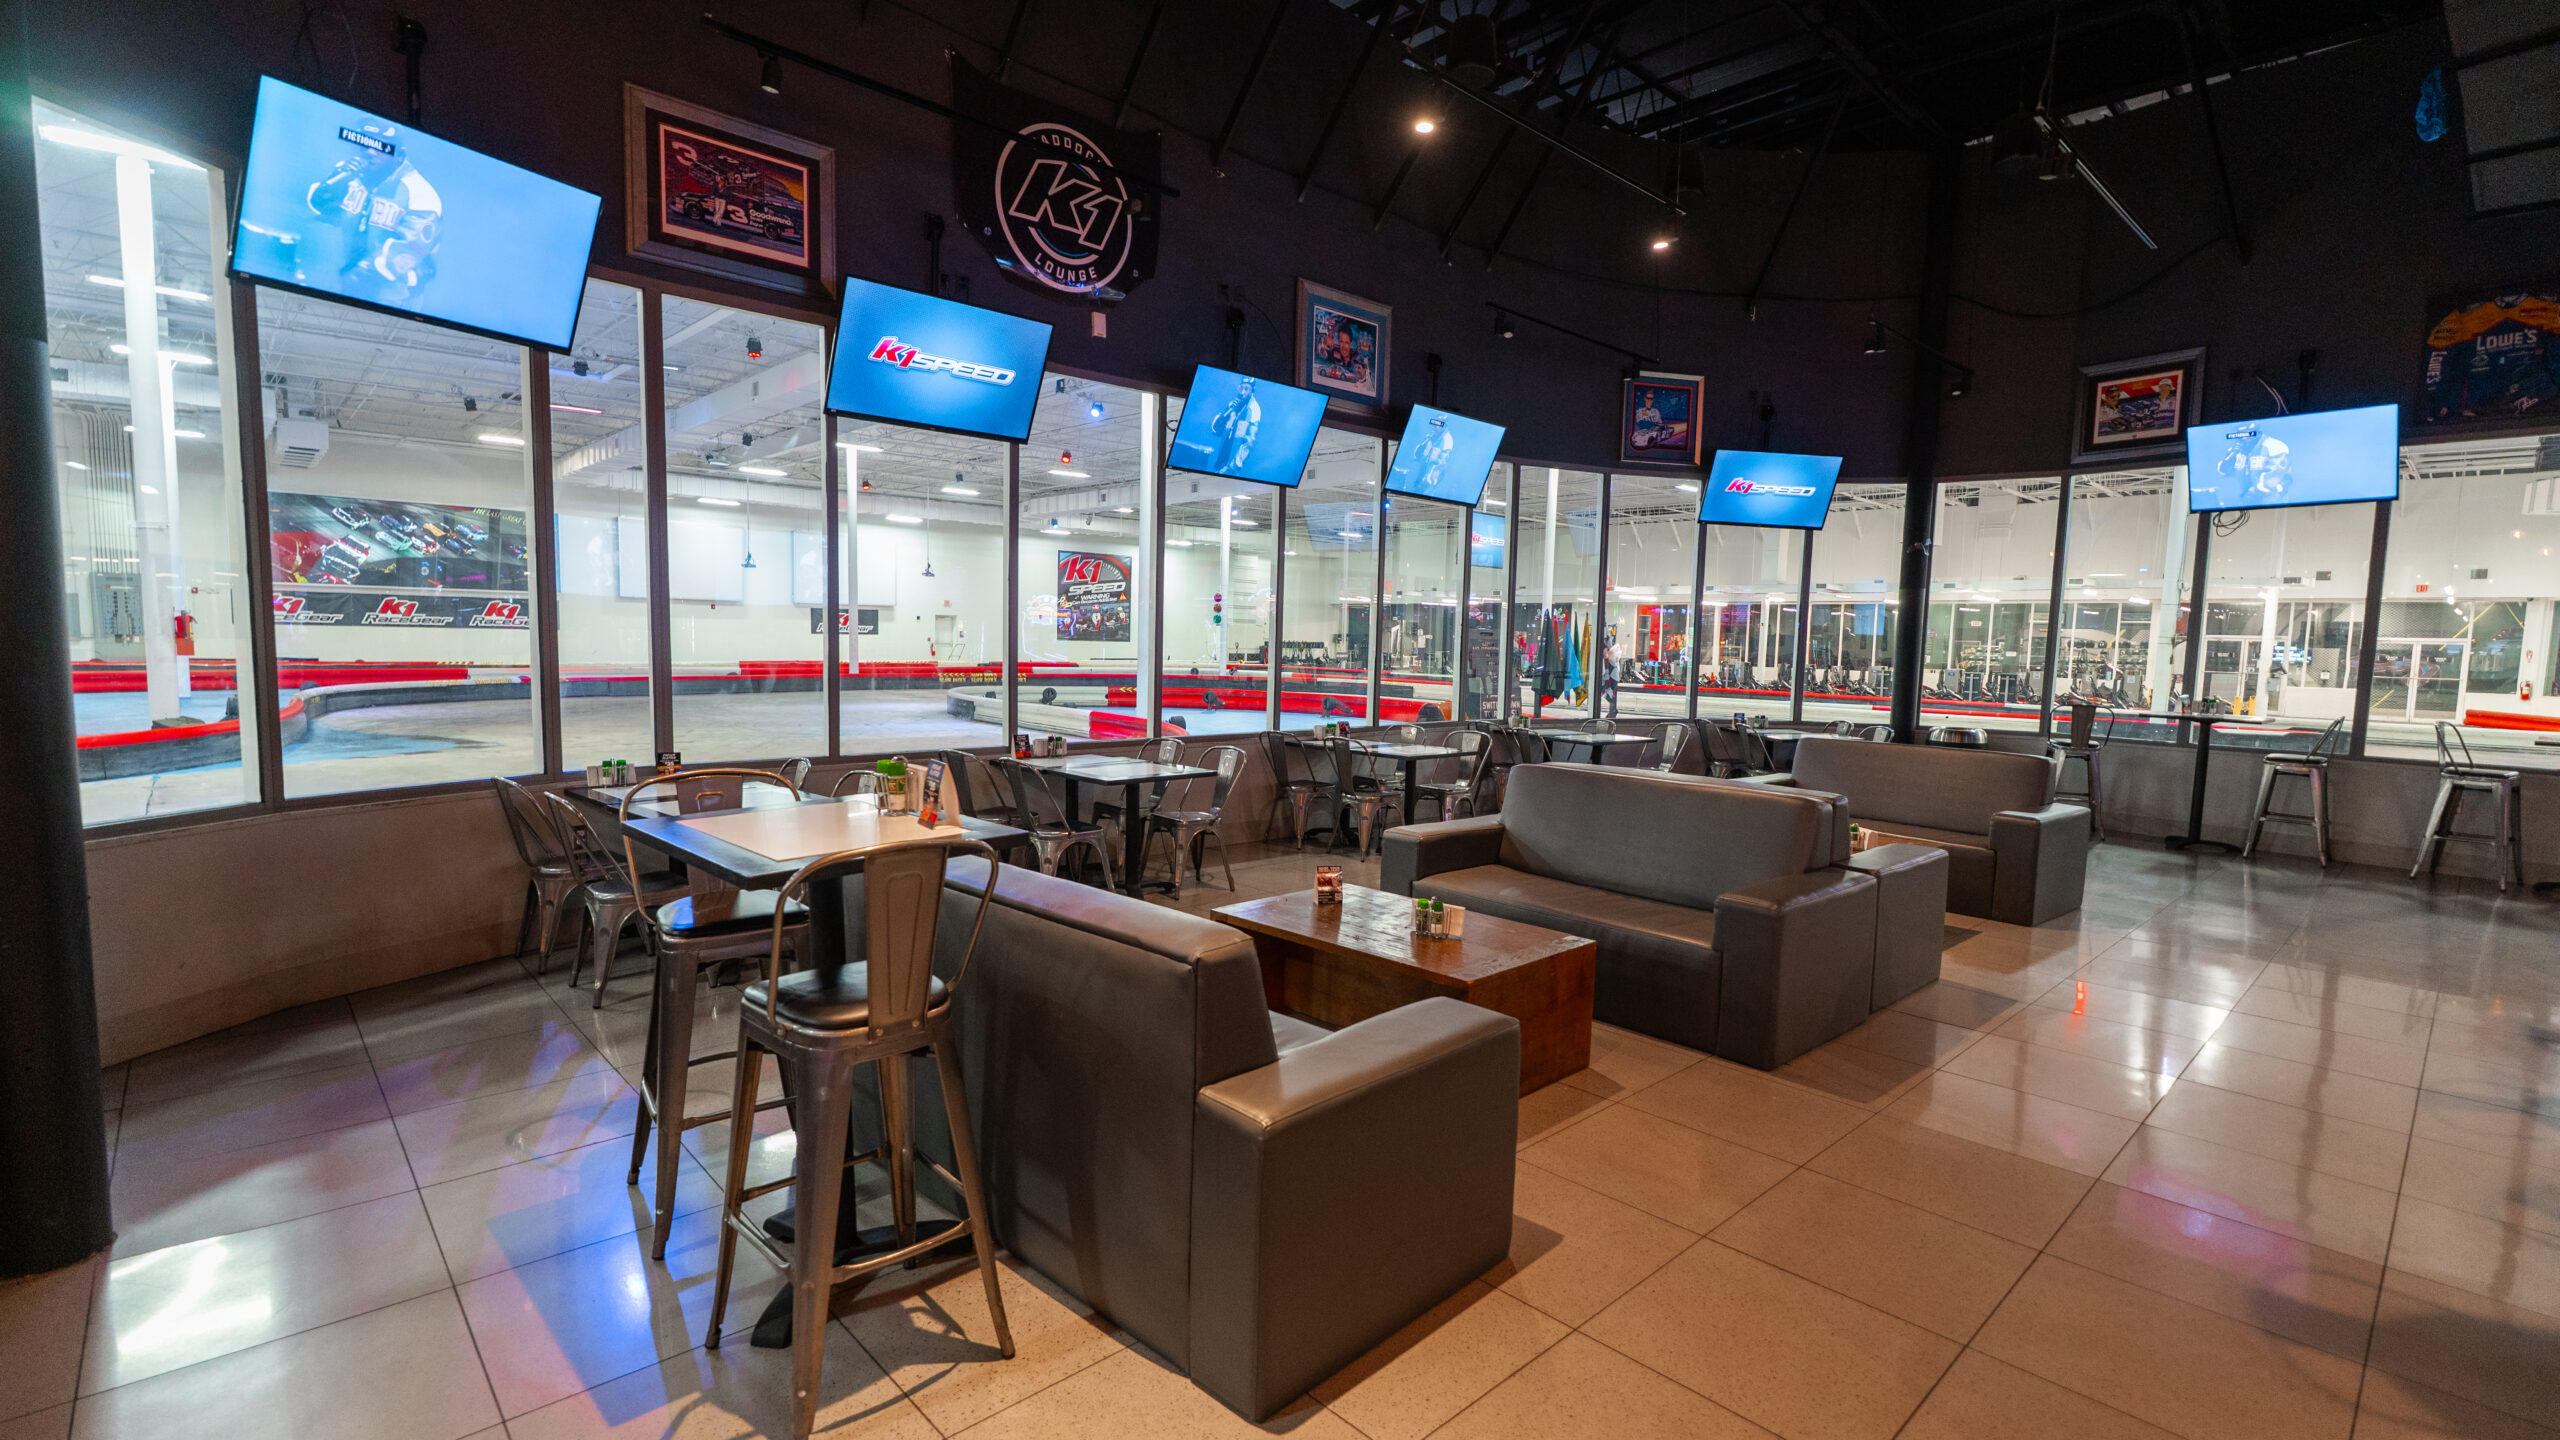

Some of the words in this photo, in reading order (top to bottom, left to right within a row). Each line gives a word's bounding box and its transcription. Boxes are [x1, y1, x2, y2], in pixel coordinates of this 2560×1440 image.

[342, 129, 384, 151] FICTIONAL
[727, 204, 749, 224] 3
[1008, 159, 1123, 250] K1
[1034, 252, 1098, 282] LOUNGE
[2476, 328, 2538, 352] LOWE'S
[1064, 555, 1103, 583] K1
[1068, 582, 1126, 596] SPEED
[1081, 593, 1111, 601] WARNING
[377, 597, 419, 617] K1
[482, 600, 521, 619] K1
[361, 612, 454, 626] RaceGear
[469, 615, 529, 627] RaceG
